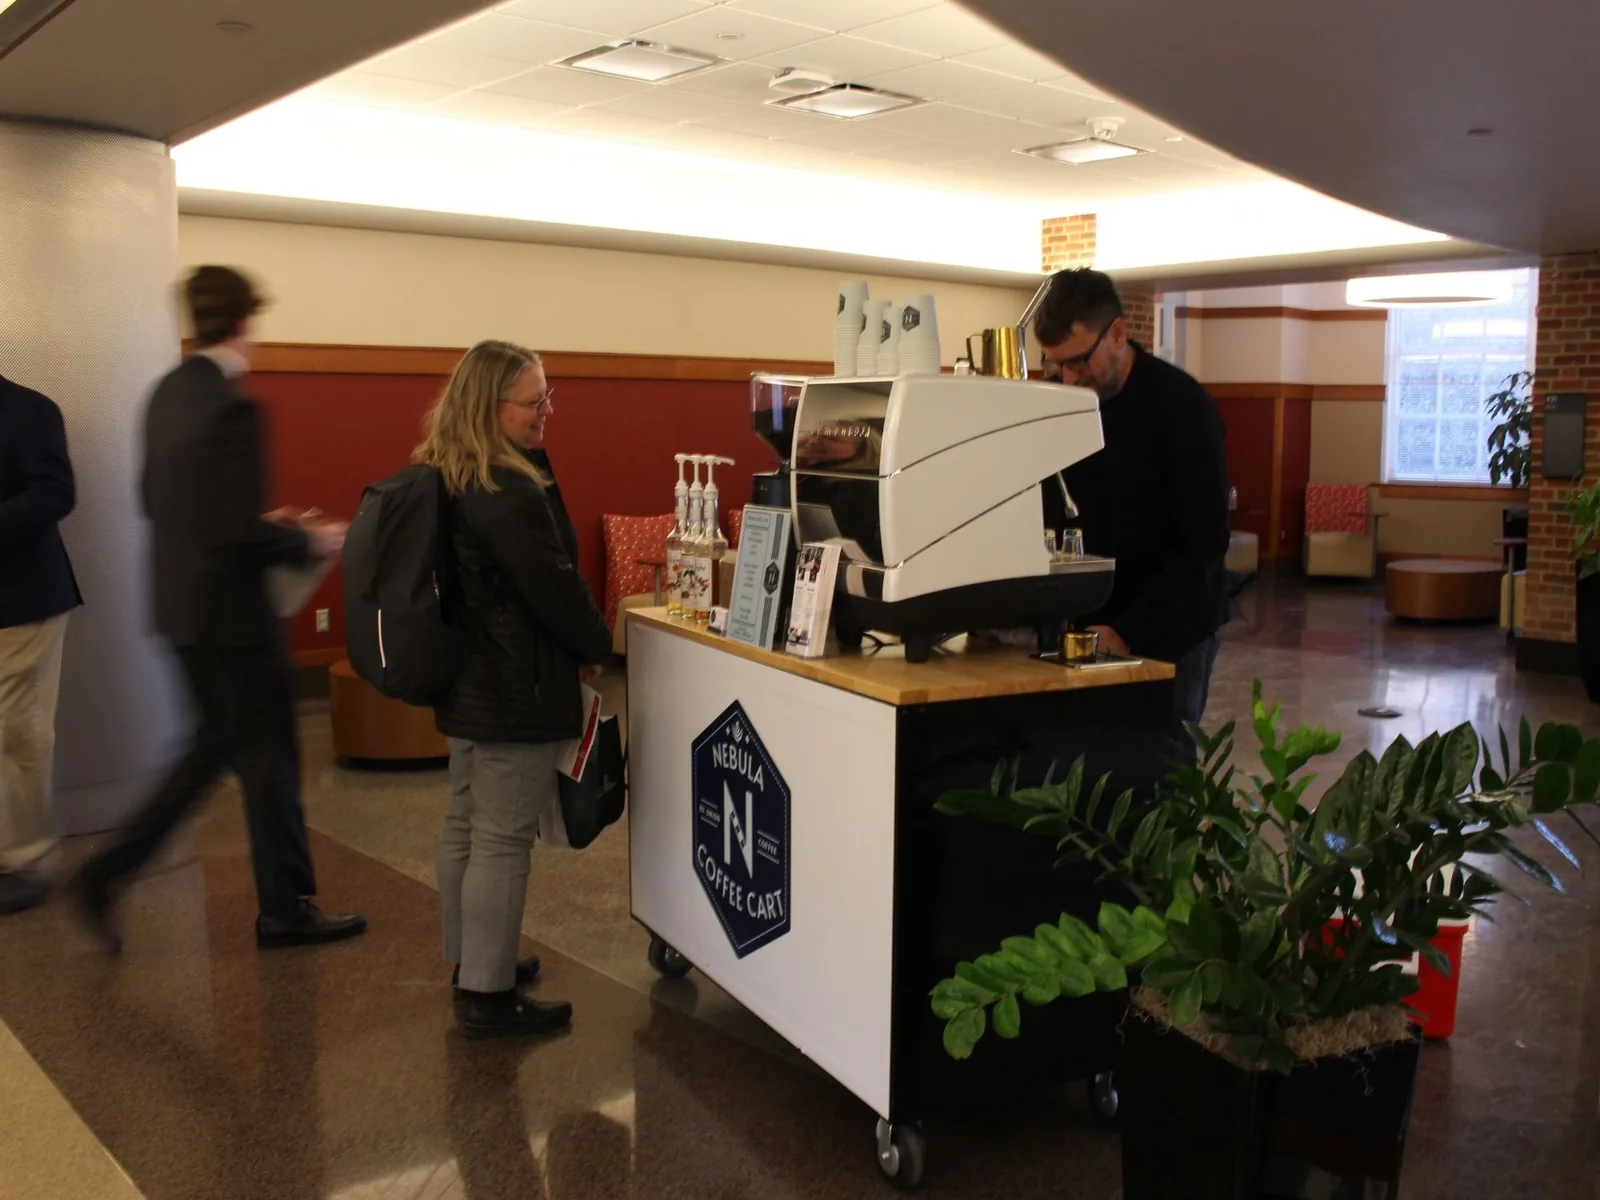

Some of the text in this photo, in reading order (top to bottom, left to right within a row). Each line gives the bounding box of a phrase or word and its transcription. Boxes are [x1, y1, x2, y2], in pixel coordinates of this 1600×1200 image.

[712, 742, 764, 792] NEBULA
[723, 779, 753, 880] N
[757, 837, 777, 856] COFFEE
[697, 843, 784, 920] COFFEE CART
